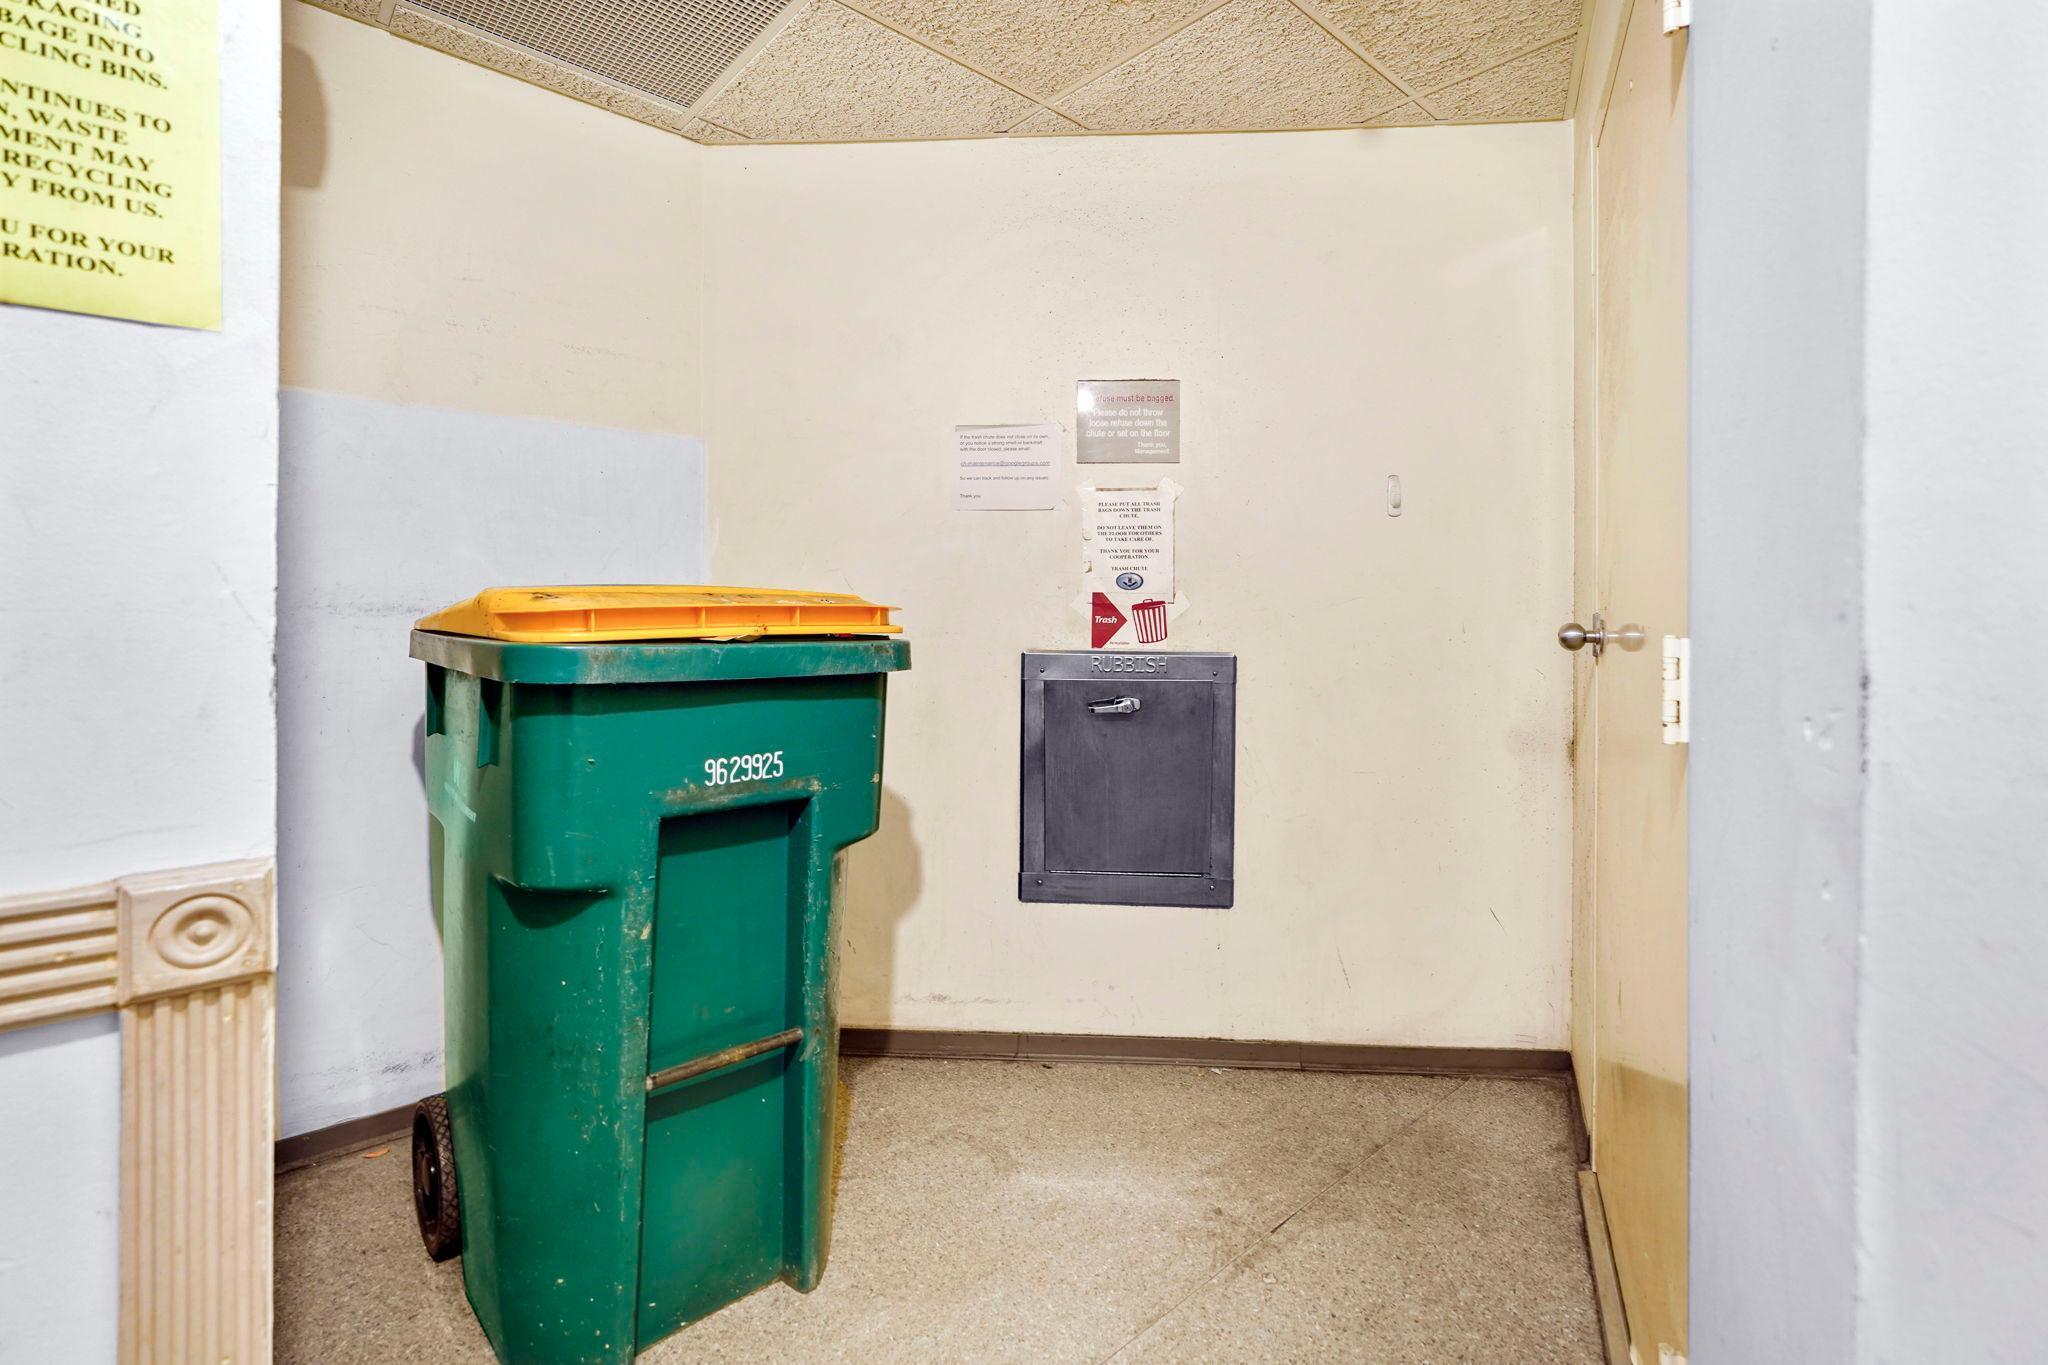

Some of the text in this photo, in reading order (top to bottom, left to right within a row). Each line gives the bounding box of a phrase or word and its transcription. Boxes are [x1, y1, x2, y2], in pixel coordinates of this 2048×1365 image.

[95, 0, 140, 16] ED
[0, 31, 168, 90] CLING BINS.
[87, 33, 154, 63] INTO
[0, 78, 171, 133] NTINUES TO
[27, 107, 128, 145] WASTE
[2, 149, 172, 198] RECYCLING
[92, 147, 154, 172] MAY
[1, 171, 163, 218] Y FROM US.
[1, 218, 175, 264] U FOR YOUR
[2, 242, 123, 277] RATION.
[1117, 394, 1133, 402] must
[1136, 394, 1144, 402] be
[1118, 407, 1128, 417] do
[1129, 407, 1141, 417] not
[1143, 407, 1164, 417] throw
[1135, 418, 1154, 427] down
[1156, 418, 1167, 427] the
[1141, 429, 1152, 437] the
[1094, 615, 1118, 624] Trash
[1090, 655, 1168, 674] RUBBISH
[704, 750, 784, 787] 9629925
